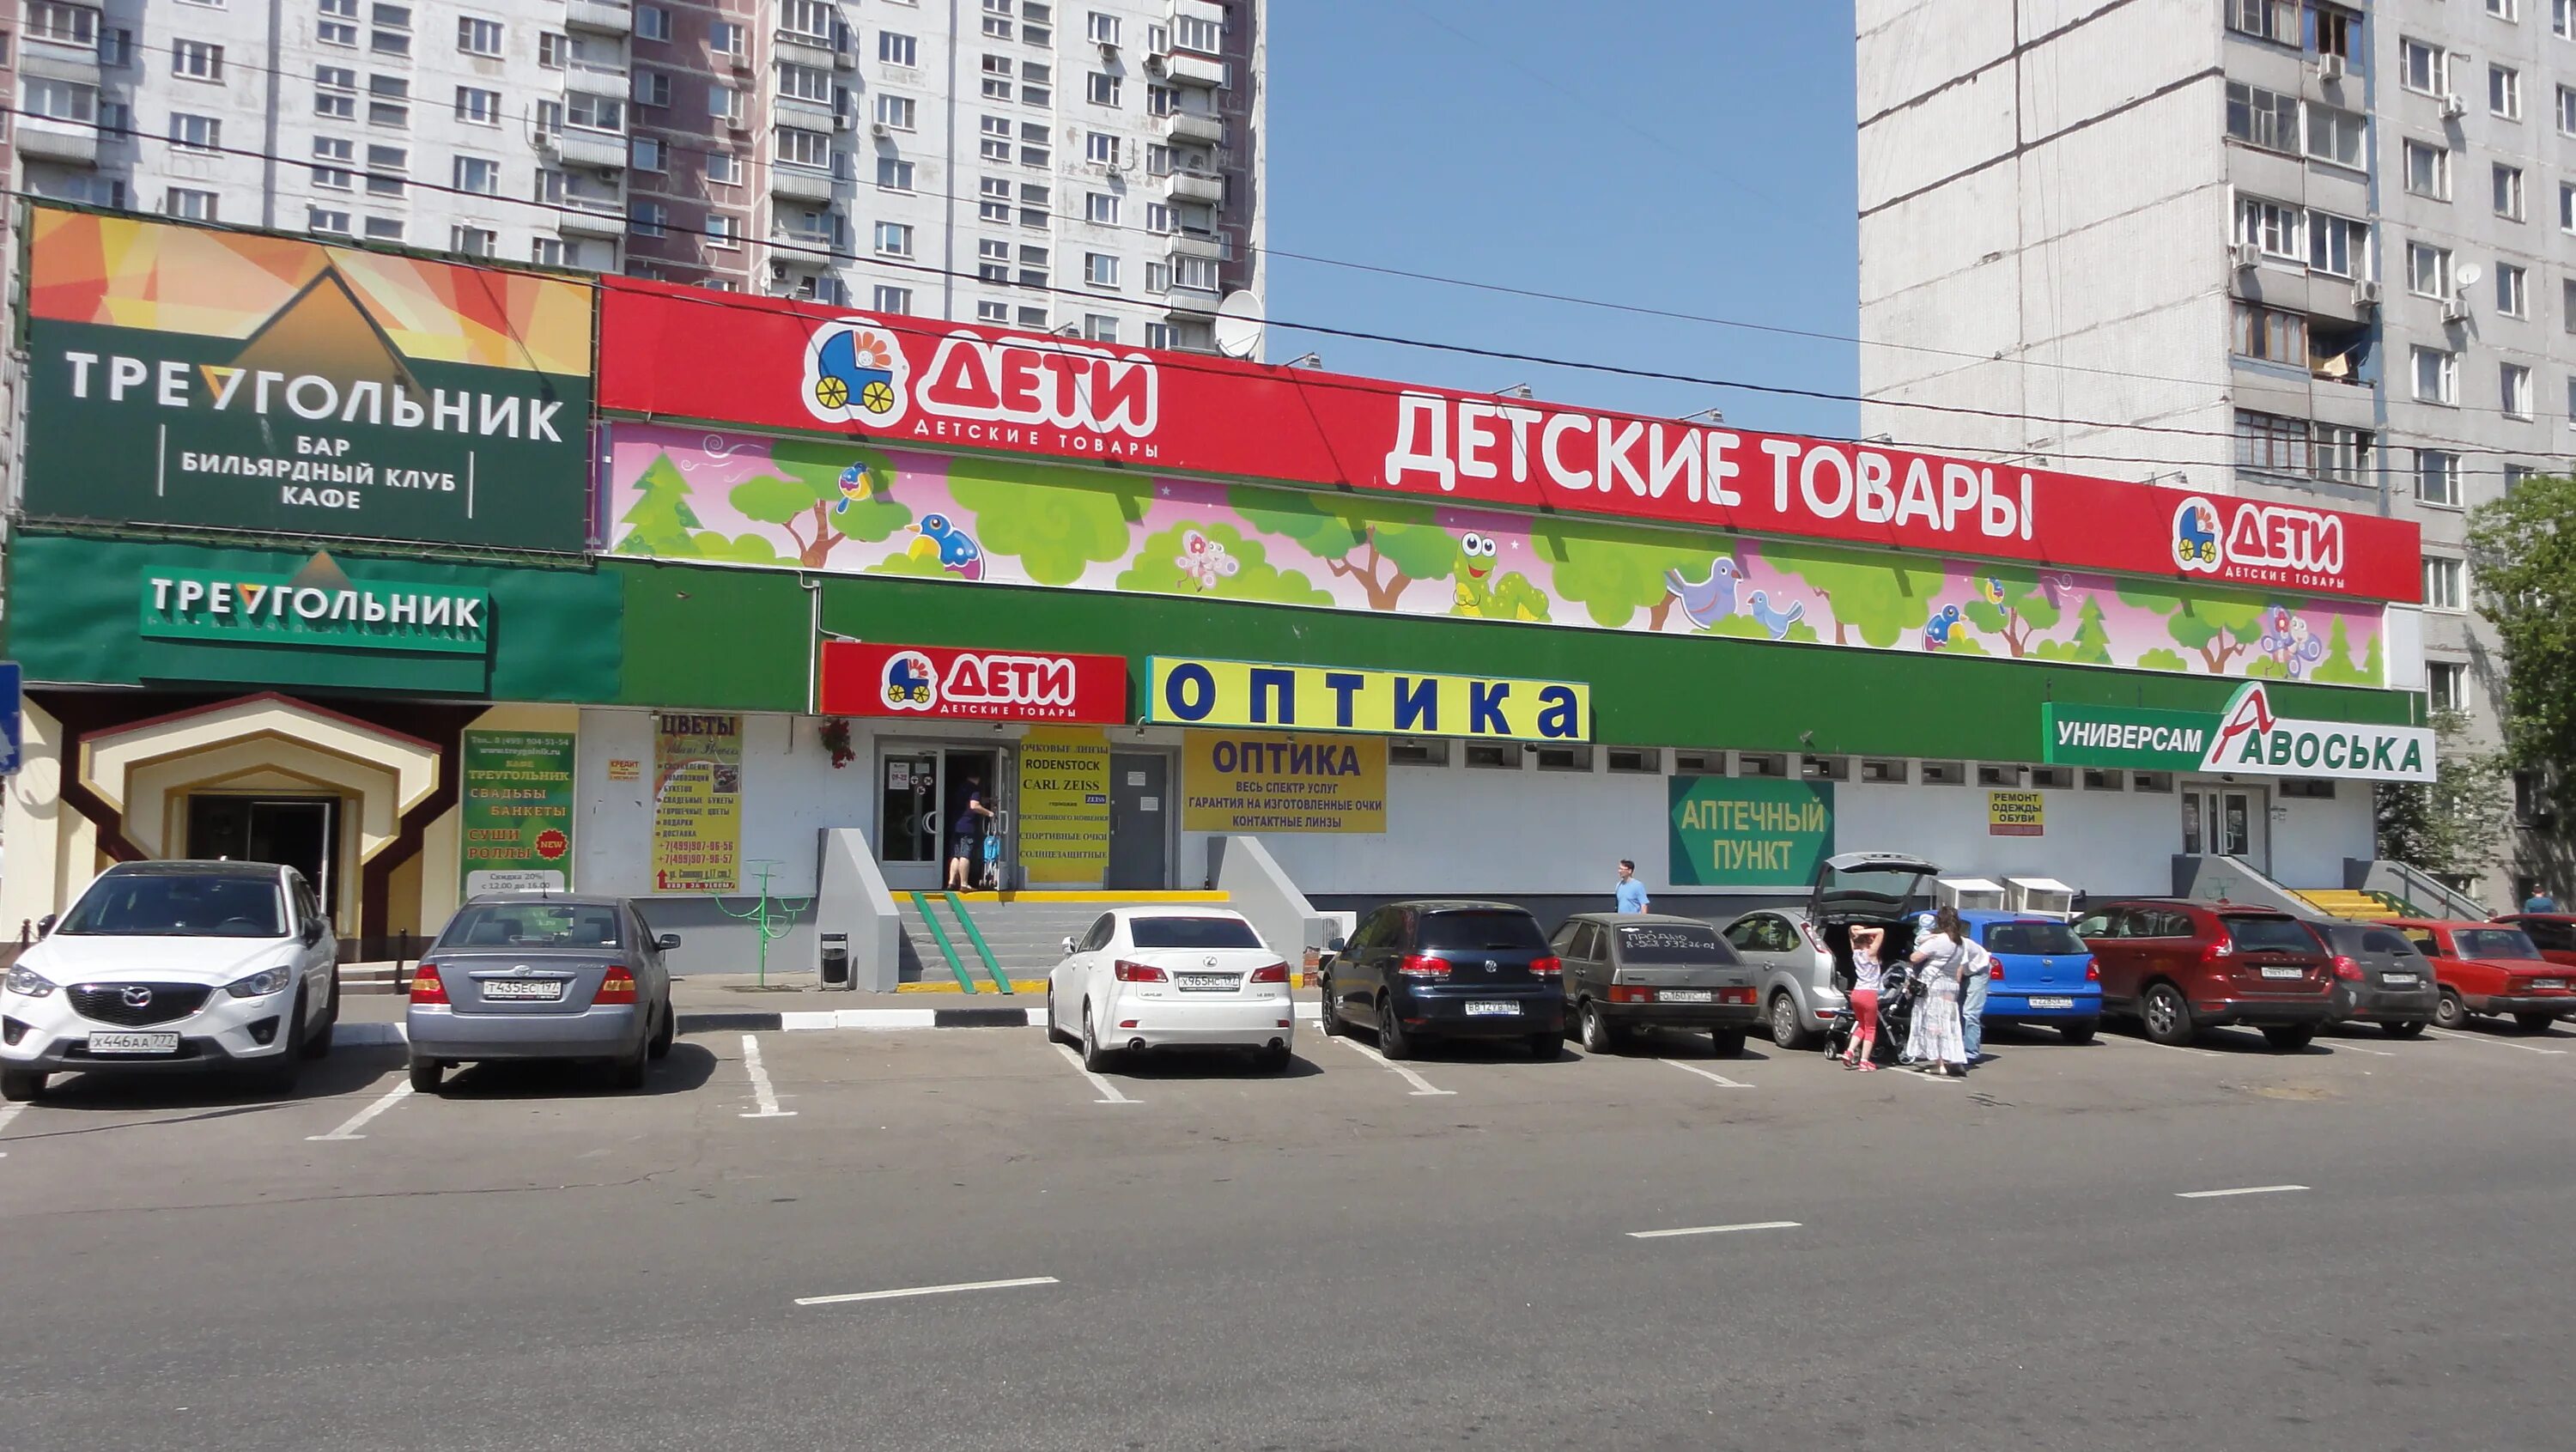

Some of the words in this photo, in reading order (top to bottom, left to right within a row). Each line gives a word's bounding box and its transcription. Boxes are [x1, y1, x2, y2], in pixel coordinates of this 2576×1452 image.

[915, 330, 1158, 438] ДЕТИ
[65, 351, 562, 442] ТРЕУГОЛЬНИК
[914, 418, 1038, 445] ДЕТСКИЕ
[1059, 434, 1158, 459] ТОВАРЫ
[296, 435, 351, 458] БАР
[181, 452, 374, 486] БИЛЬЯРДНЫЙ
[386, 468, 456, 492] КЛУБ
[1385, 391, 1741, 507] ДЕТСКИЕ
[1761, 439, 2032, 541] ТОВАРЫ
[282, 485, 361, 509] КАФЕ
[2226, 503, 2342, 574] ДЕТИ
[2225, 566, 2287, 582] ДЕТСКИЕ
[2295, 574, 2345, 588] ТОВАРЫ
[150, 578, 480, 629] ТРЕУГОЛЬНИК
[941, 653, 1075, 707] ДЕТИ
[940, 704, 1009, 715] ДЕТСКИЕ
[1019, 707, 1076, 717] ТОВАРЫ
[661, 714, 735, 736] ЦВЕТЫ
[2057, 720, 2203, 753] УНИВЕРСАМ
[1021, 744, 1070, 753] ОЧКОВЫЕ
[2238, 728, 2423, 774] АВОСЬКА
[1025, 759, 1101, 771] RODENSTOCK
[1212, 741, 1361, 776] ОПТИКА
[468, 770, 569, 781] ТРЕУГОЛЬНИК
[1023, 779, 1060, 790] CARL
[1063, 780, 1100, 791] ZEISS
[1236, 781, 1263, 793] ВЕСЬ
[1266, 782, 1305, 793] СПЕКТР
[1308, 783, 1339, 794] УСЛУГ
[470, 788, 547, 799] СВАДЬБЫ
[1994, 793, 2038, 802] РЕМОНТ
[1188, 797, 1244, 809] ГАРАНТИЯ
[1247, 799, 1261, 810] НА
[1264, 799, 1352, 811] ИЗГОТОВЛЕННЫЕ
[1355, 800, 1382, 811] ОЧКИ
[1992, 803, 2043, 814] ОДЕЖДЫ
[490, 805, 567, 817] БАНКЕТЫ
[1680, 797, 1826, 832] АПТЕЧНЫЙ
[1232, 816, 1303, 828] КОНТАКТНЫЕ
[1305, 817, 1342, 829] ЛИНЗЫ
[1999, 814, 2035, 823] ОБУВИ
[468, 829, 520, 841] СУШИ
[1019, 832, 1081, 841] СПОРТИВНЫЕ
[467, 847, 532, 860] РОЛЛЫ
[1019, 851, 1108, 860] СОЛНЦЕЗАЩИТНЫЕ
[1712, 839, 1794, 870] ПУНКТ
[489, 981, 537, 993] Т435ЕС
[152, 1035, 174, 1045] 777
